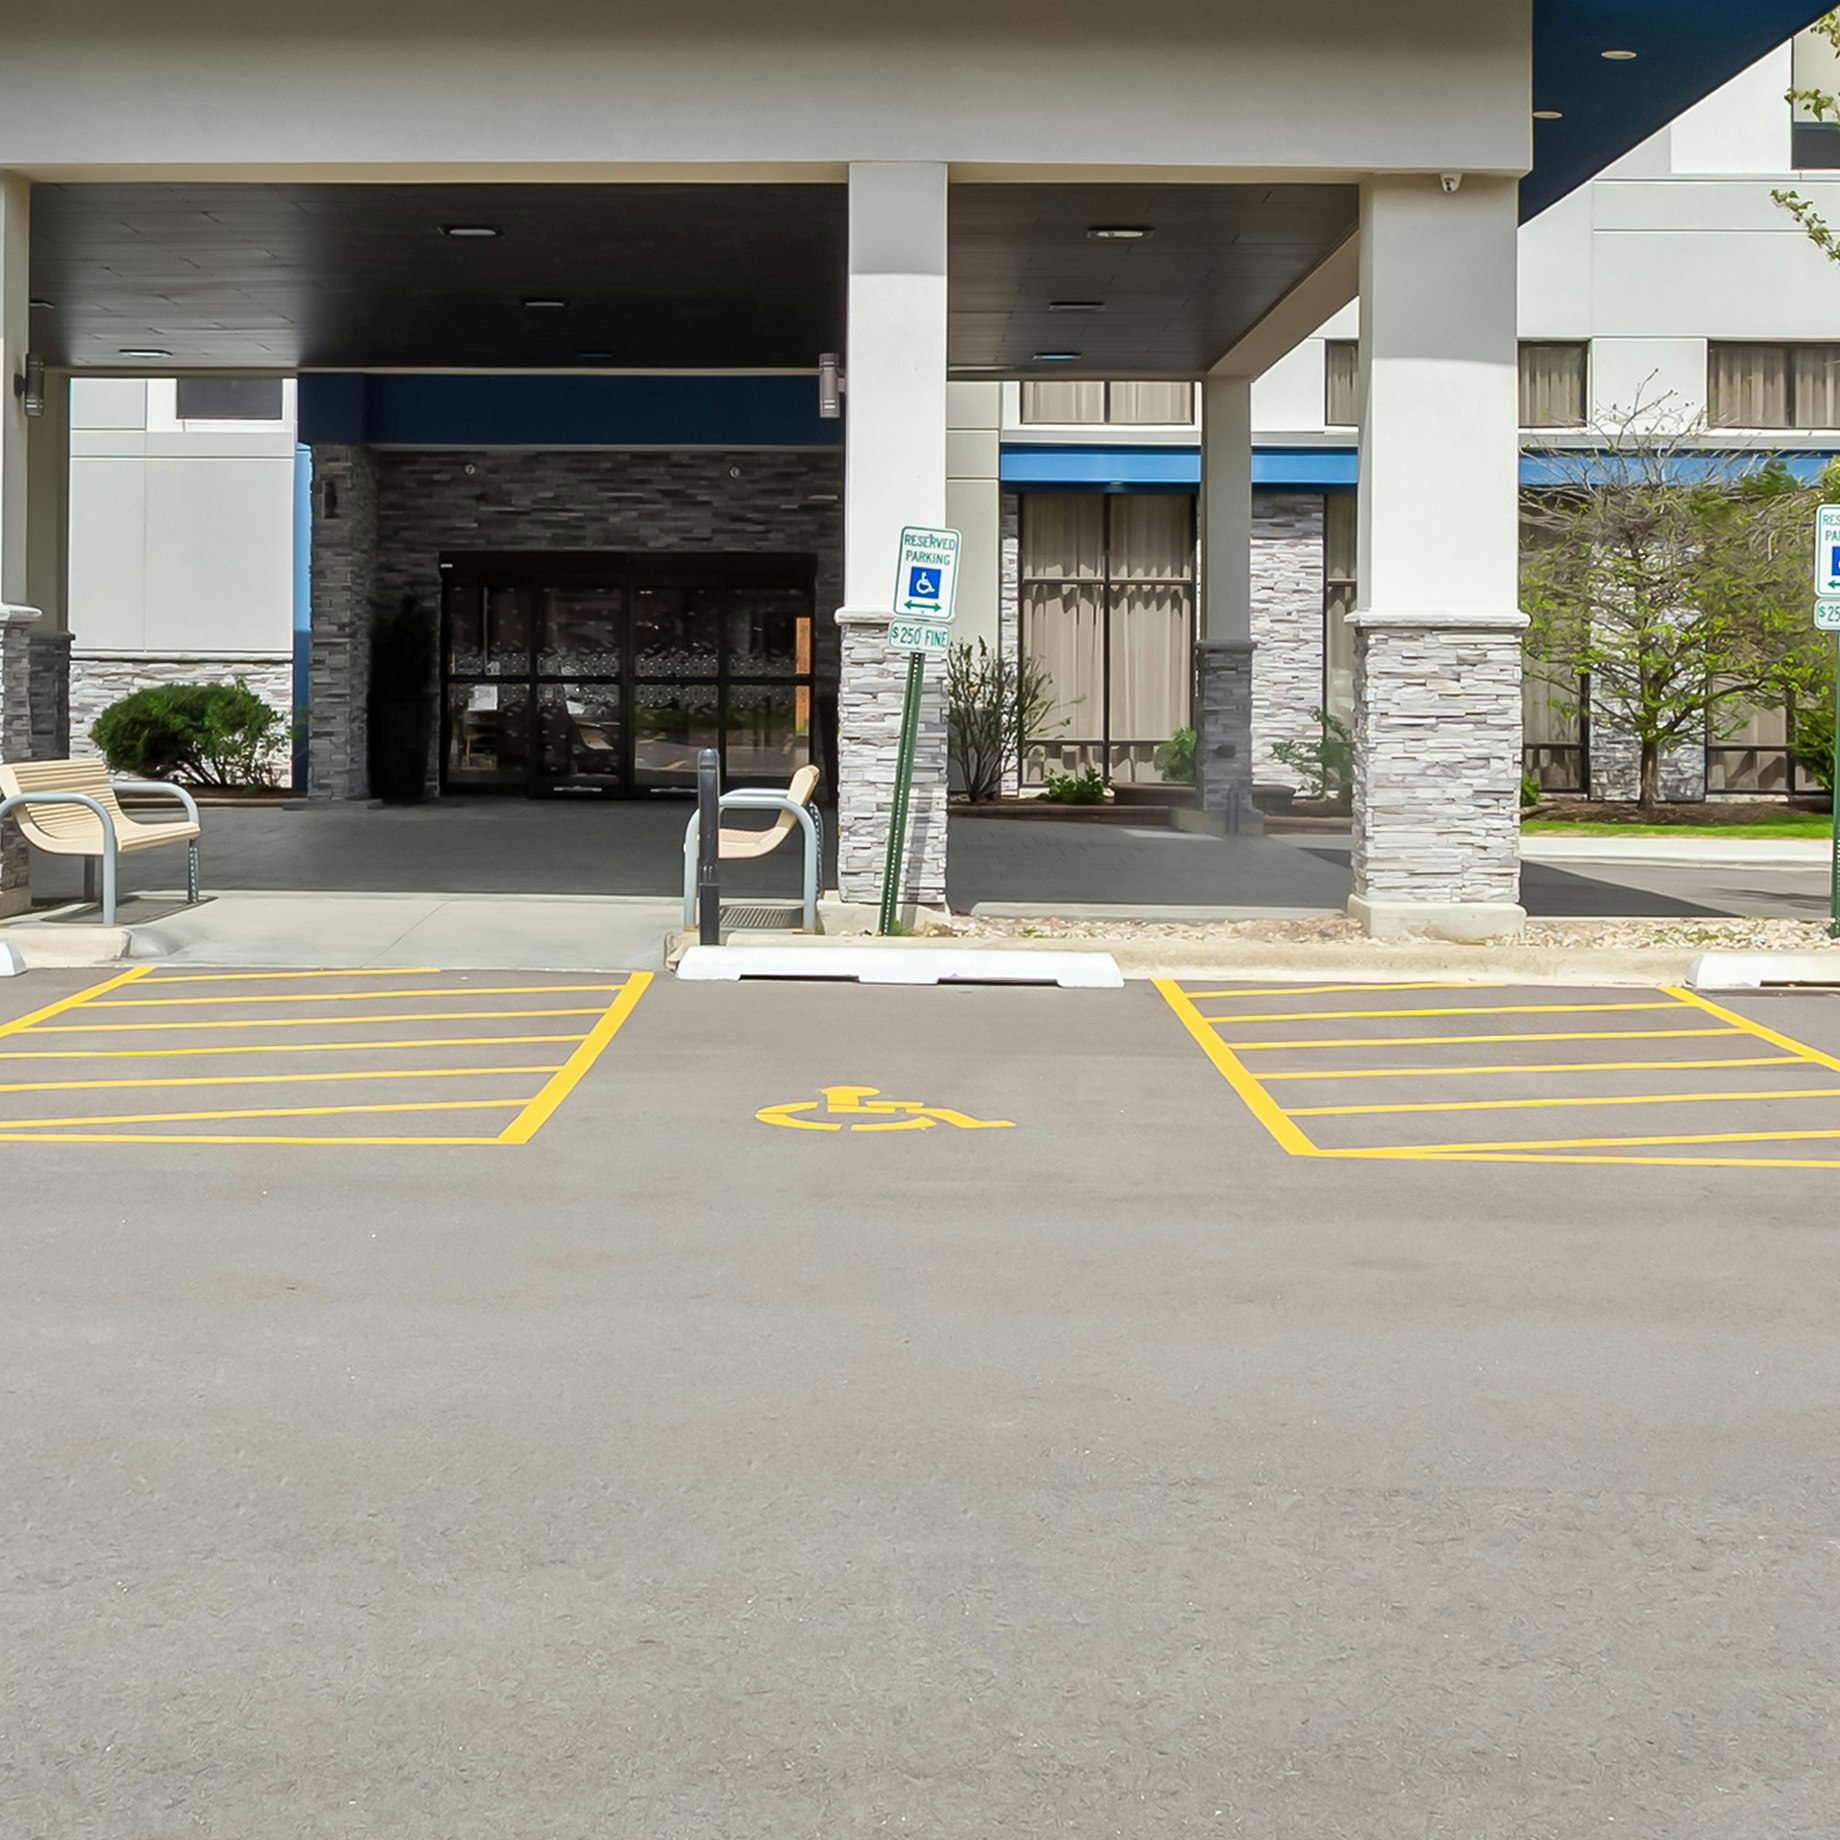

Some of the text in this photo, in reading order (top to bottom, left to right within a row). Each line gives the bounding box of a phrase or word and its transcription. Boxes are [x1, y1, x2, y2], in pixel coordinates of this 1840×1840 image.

[904, 534, 957, 551] RESERVED
[905, 550, 951, 566] PARKING
[924, 629, 949, 648] FINE
